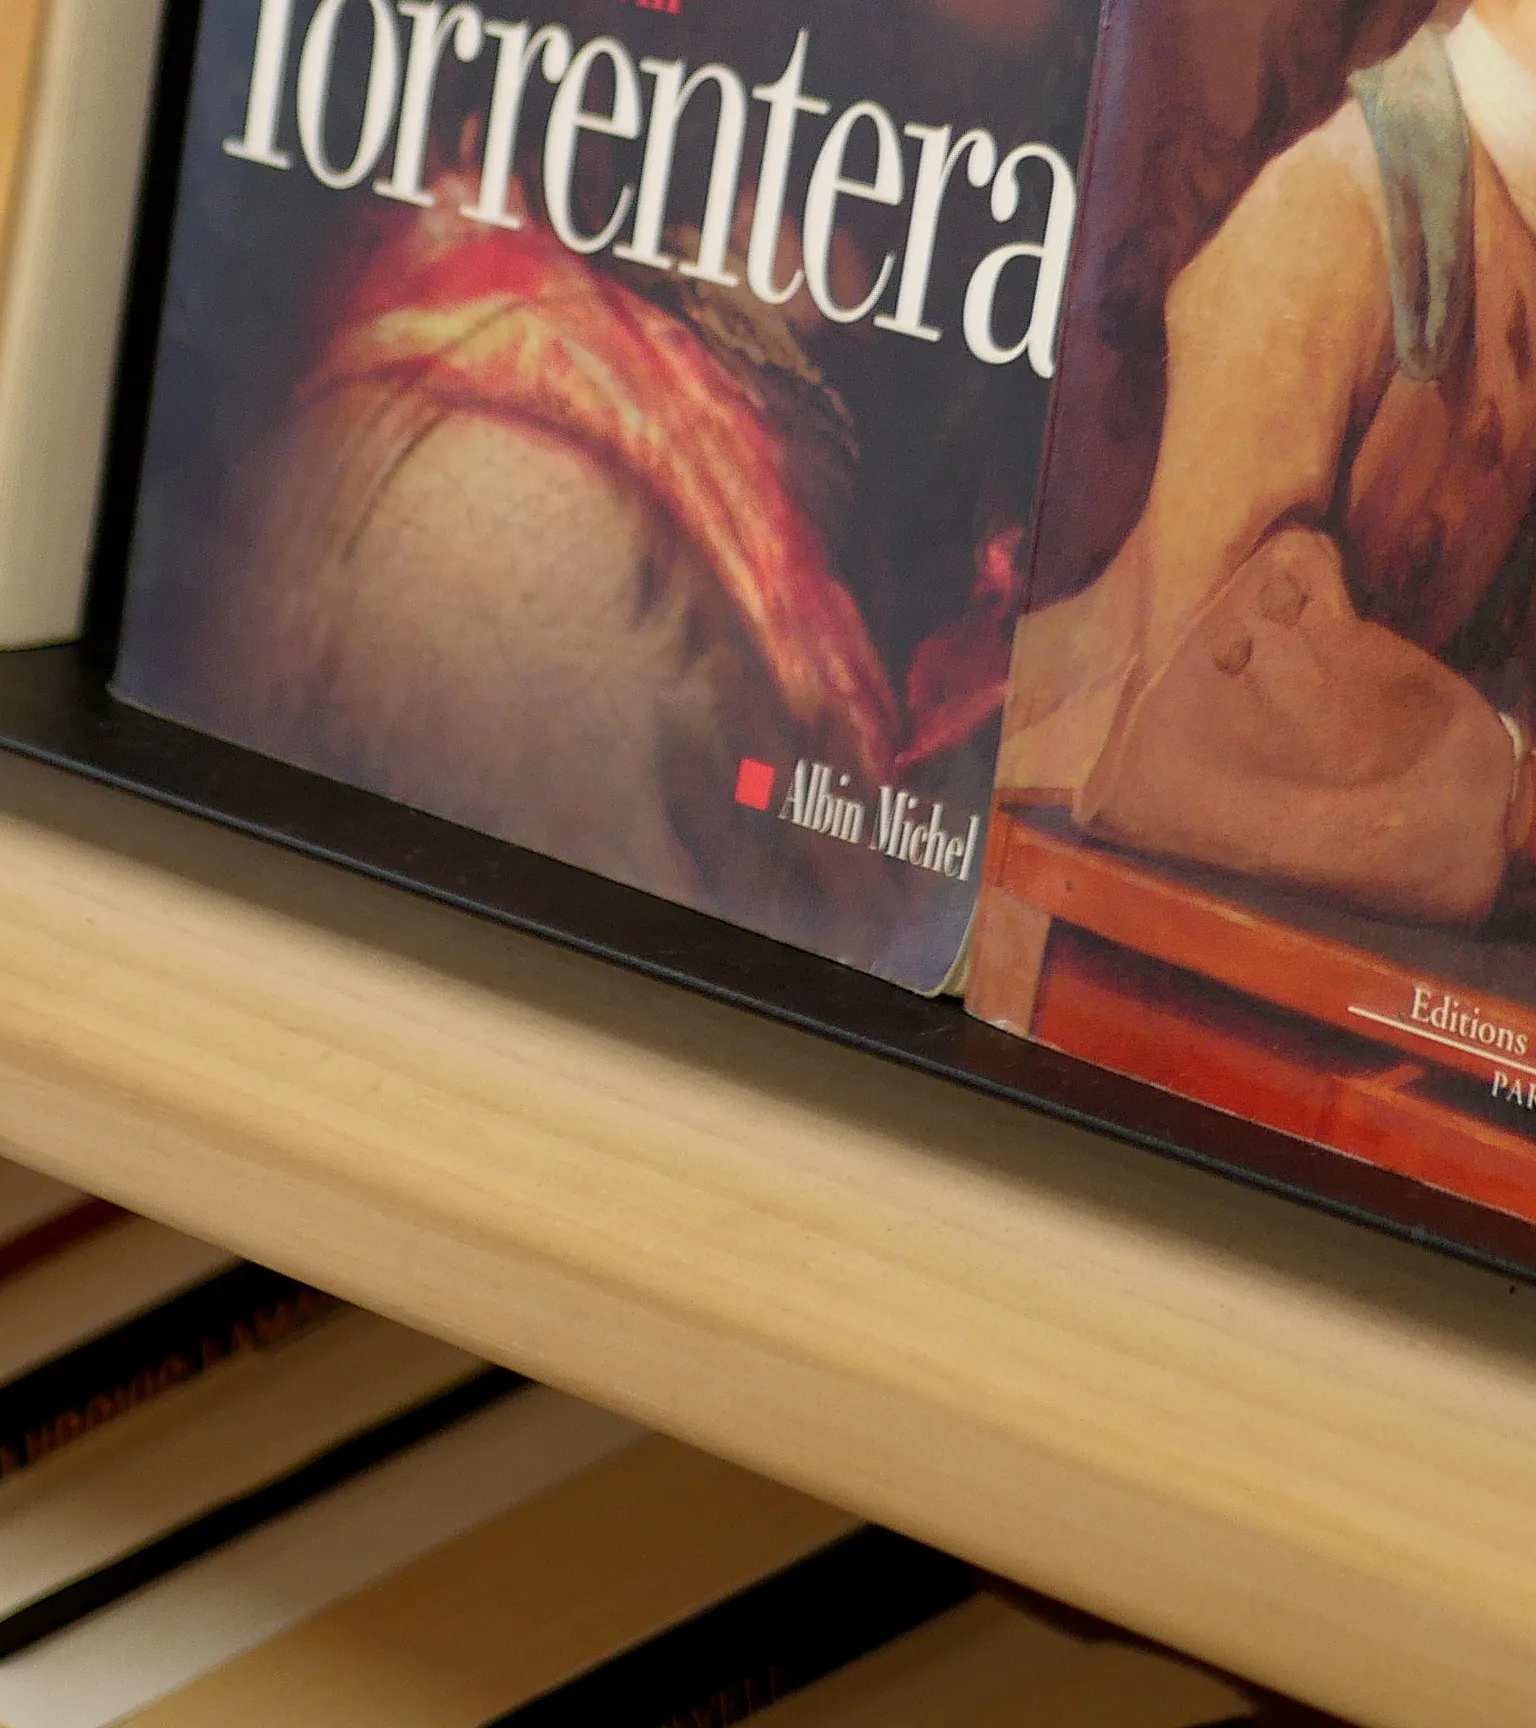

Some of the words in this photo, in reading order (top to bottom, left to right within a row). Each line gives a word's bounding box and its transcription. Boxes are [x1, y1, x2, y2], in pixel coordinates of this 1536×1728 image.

[778, 758, 864, 845] Albin
[868, 784, 981, 882] Michel
[1410, 986, 1528, 1056] Editions
